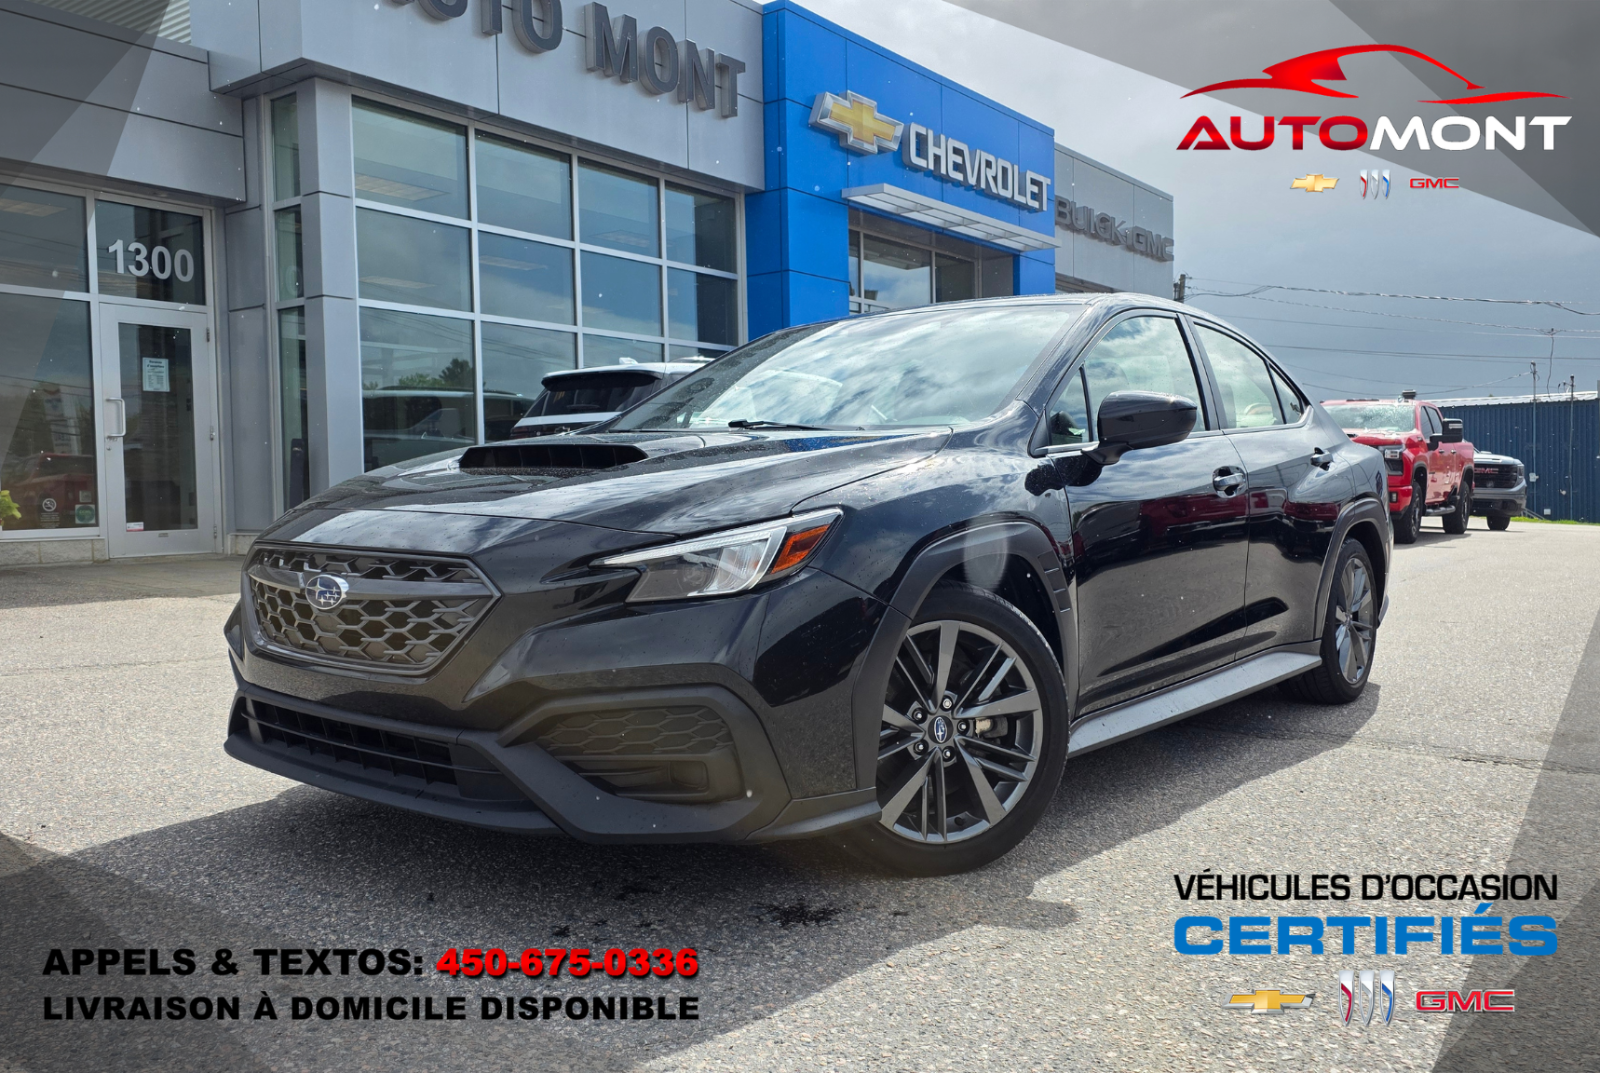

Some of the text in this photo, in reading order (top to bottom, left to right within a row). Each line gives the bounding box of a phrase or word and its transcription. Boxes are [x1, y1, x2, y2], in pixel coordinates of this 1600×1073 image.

[583, 1, 746, 118] MONT
[903, 122, 1051, 212] CHEVROLET
[108, 239, 195, 283] 1300
[1054, 195, 1174, 262] BUICK GMC
